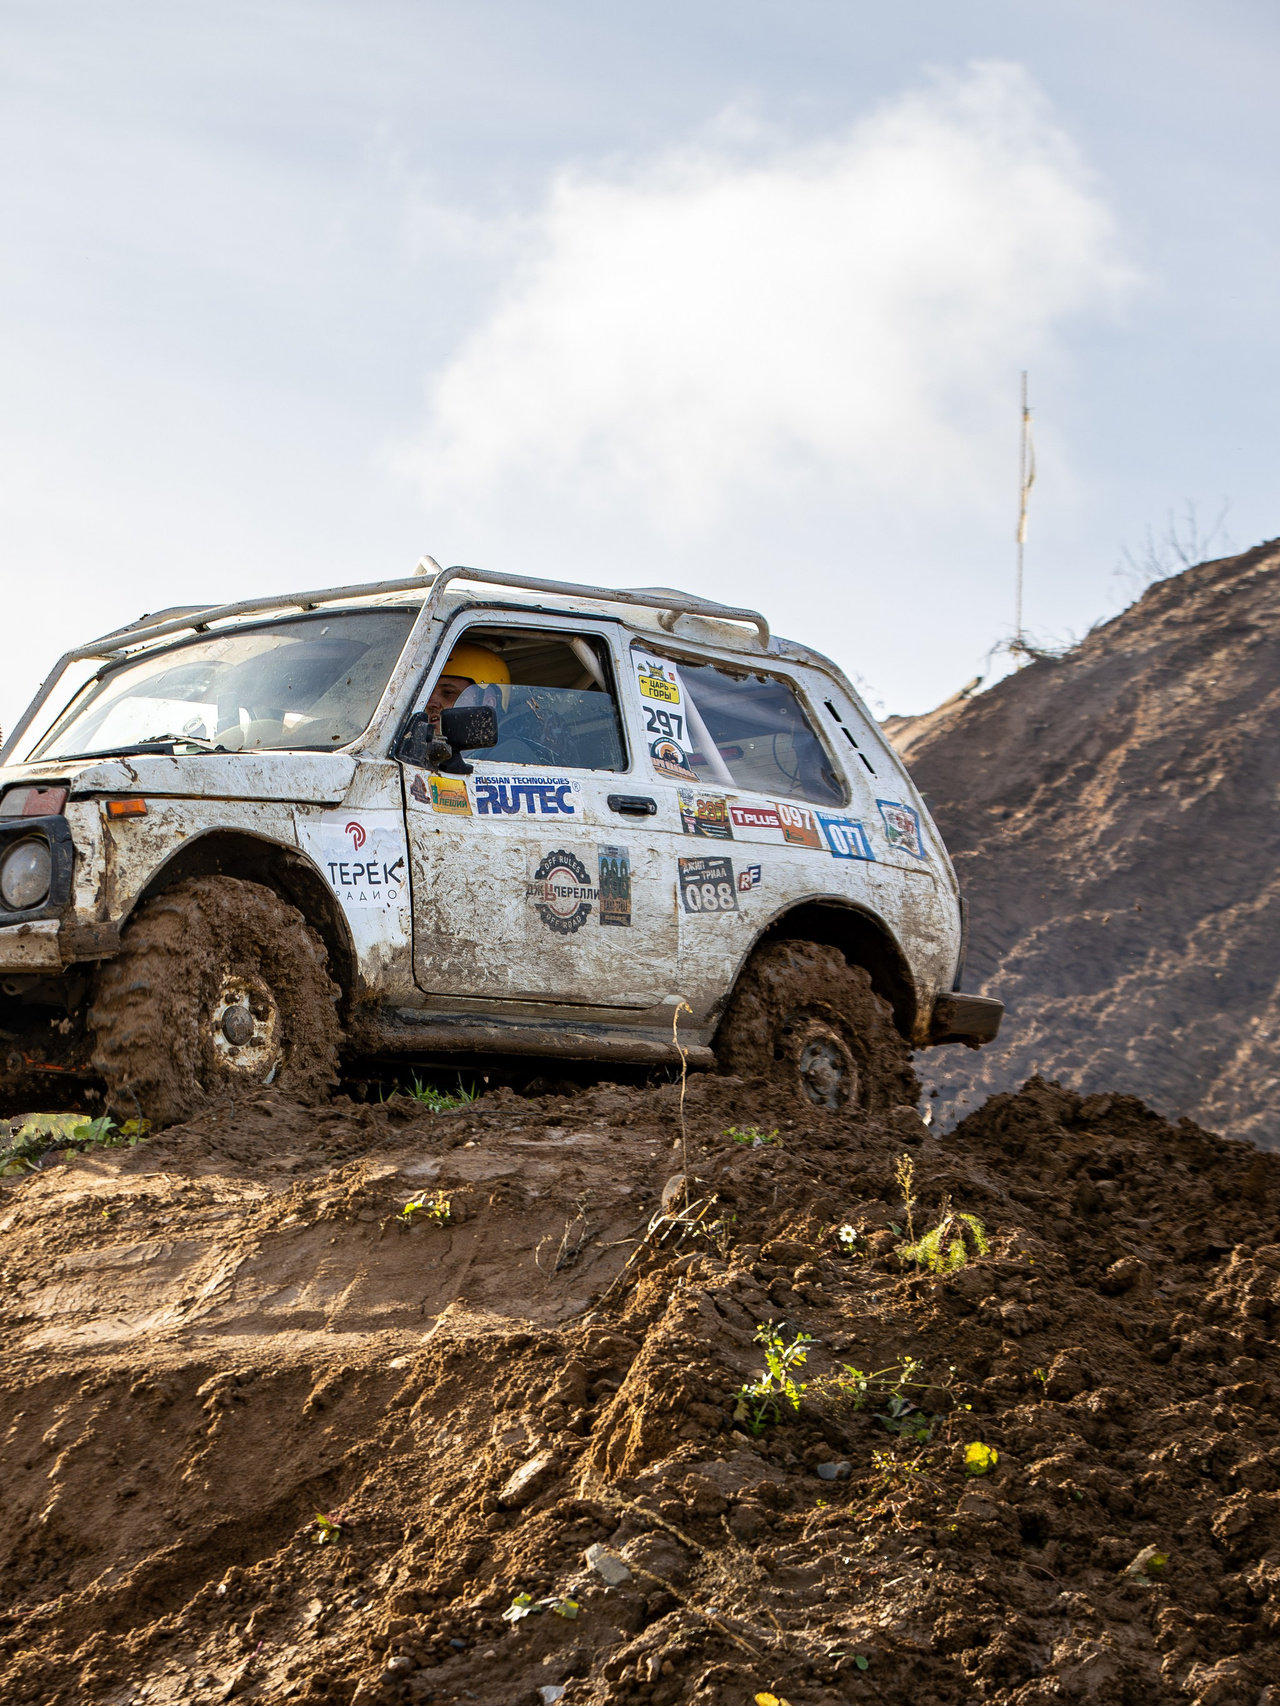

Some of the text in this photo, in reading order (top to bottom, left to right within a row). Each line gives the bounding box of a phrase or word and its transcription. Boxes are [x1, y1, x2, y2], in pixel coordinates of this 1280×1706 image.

[649, 687, 672, 700] ГОРЫ
[650, 680, 669, 690] ЦАРЬ
[642, 705, 682, 740] 297
[475, 776, 570, 785] RUSSIAN TECHNOLOGIES
[475, 785, 575, 815] RUTEC
[696, 799, 725, 822] 297
[778, 804, 812, 830] 097
[327, 861, 403, 886] ТЕРЕК
[544, 856, 581, 873] OFF RULES
[685, 882, 735, 911] 088
